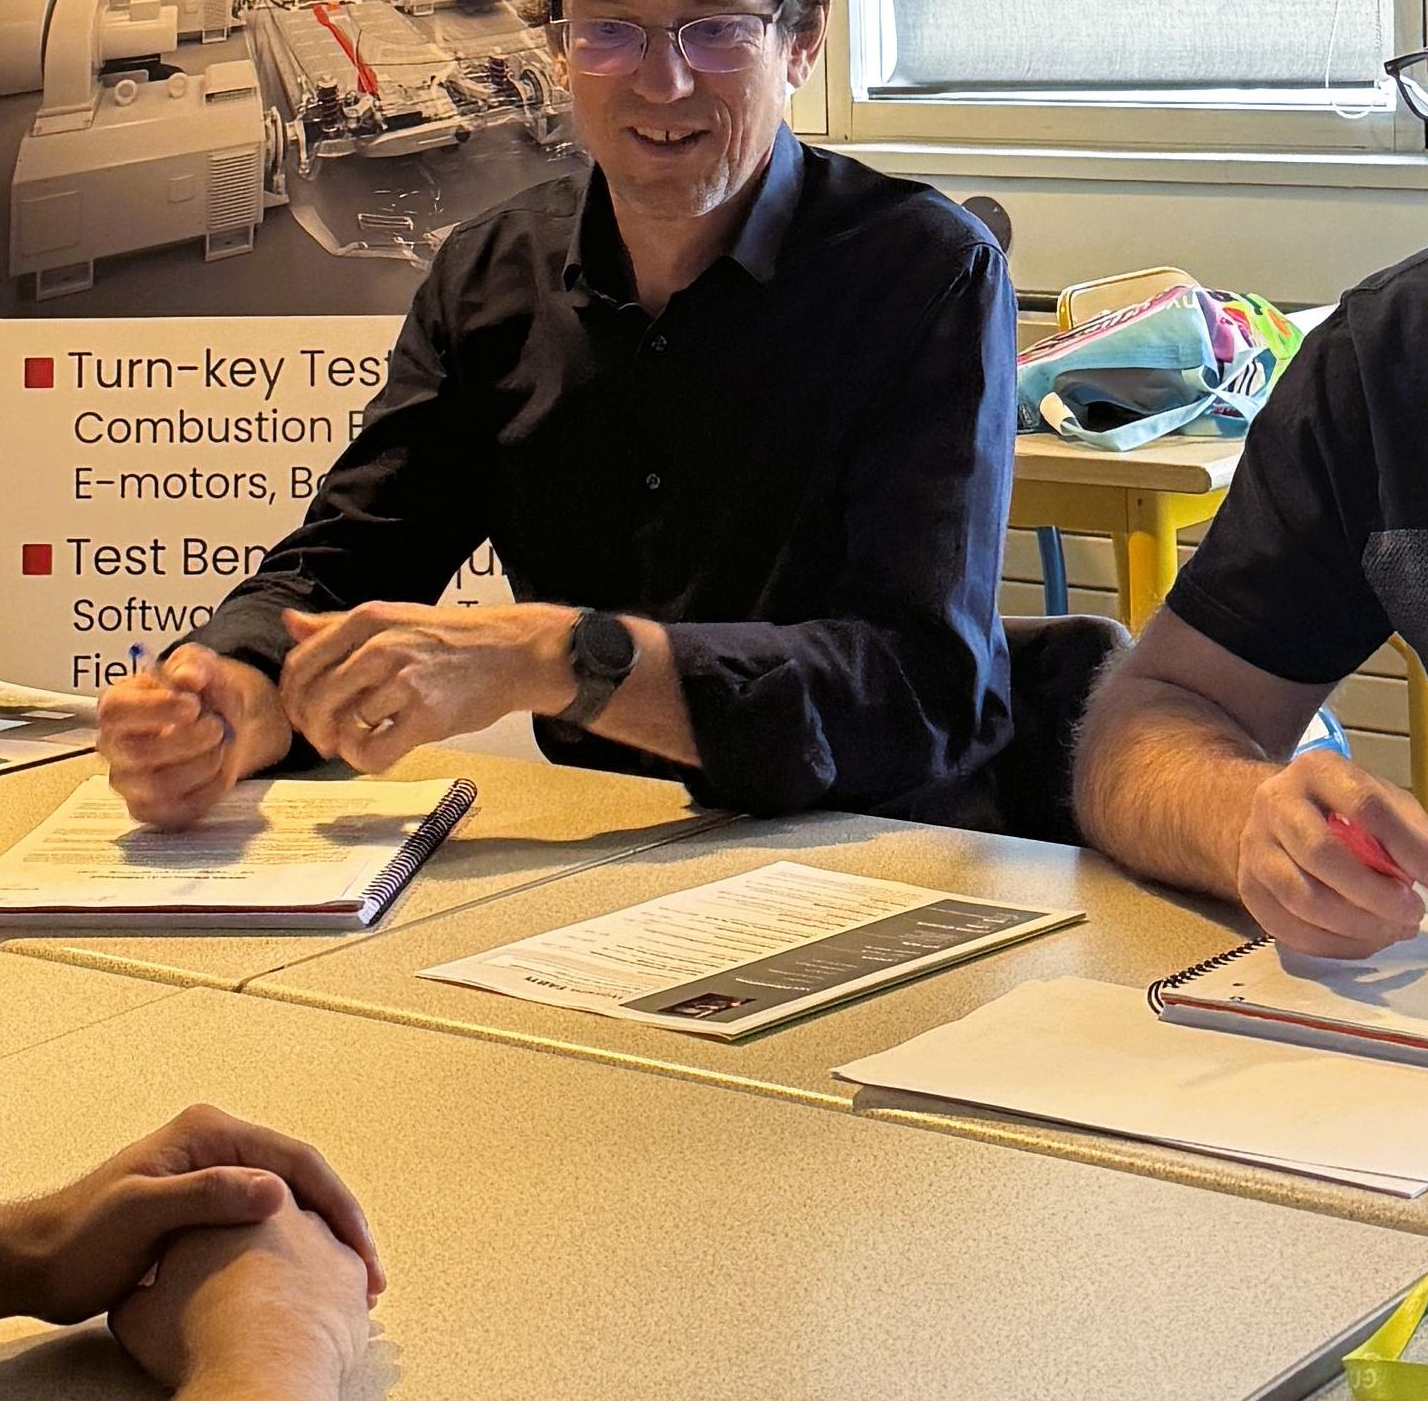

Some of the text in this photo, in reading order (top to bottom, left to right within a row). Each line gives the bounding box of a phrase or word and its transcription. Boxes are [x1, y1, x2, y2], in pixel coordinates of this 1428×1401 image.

[68, 348, 285, 401] Turn-key
[74, 408, 333, 444] Combustion
[75, 466, 276, 505] E-motors,
[66, 538, 167, 576] Test
